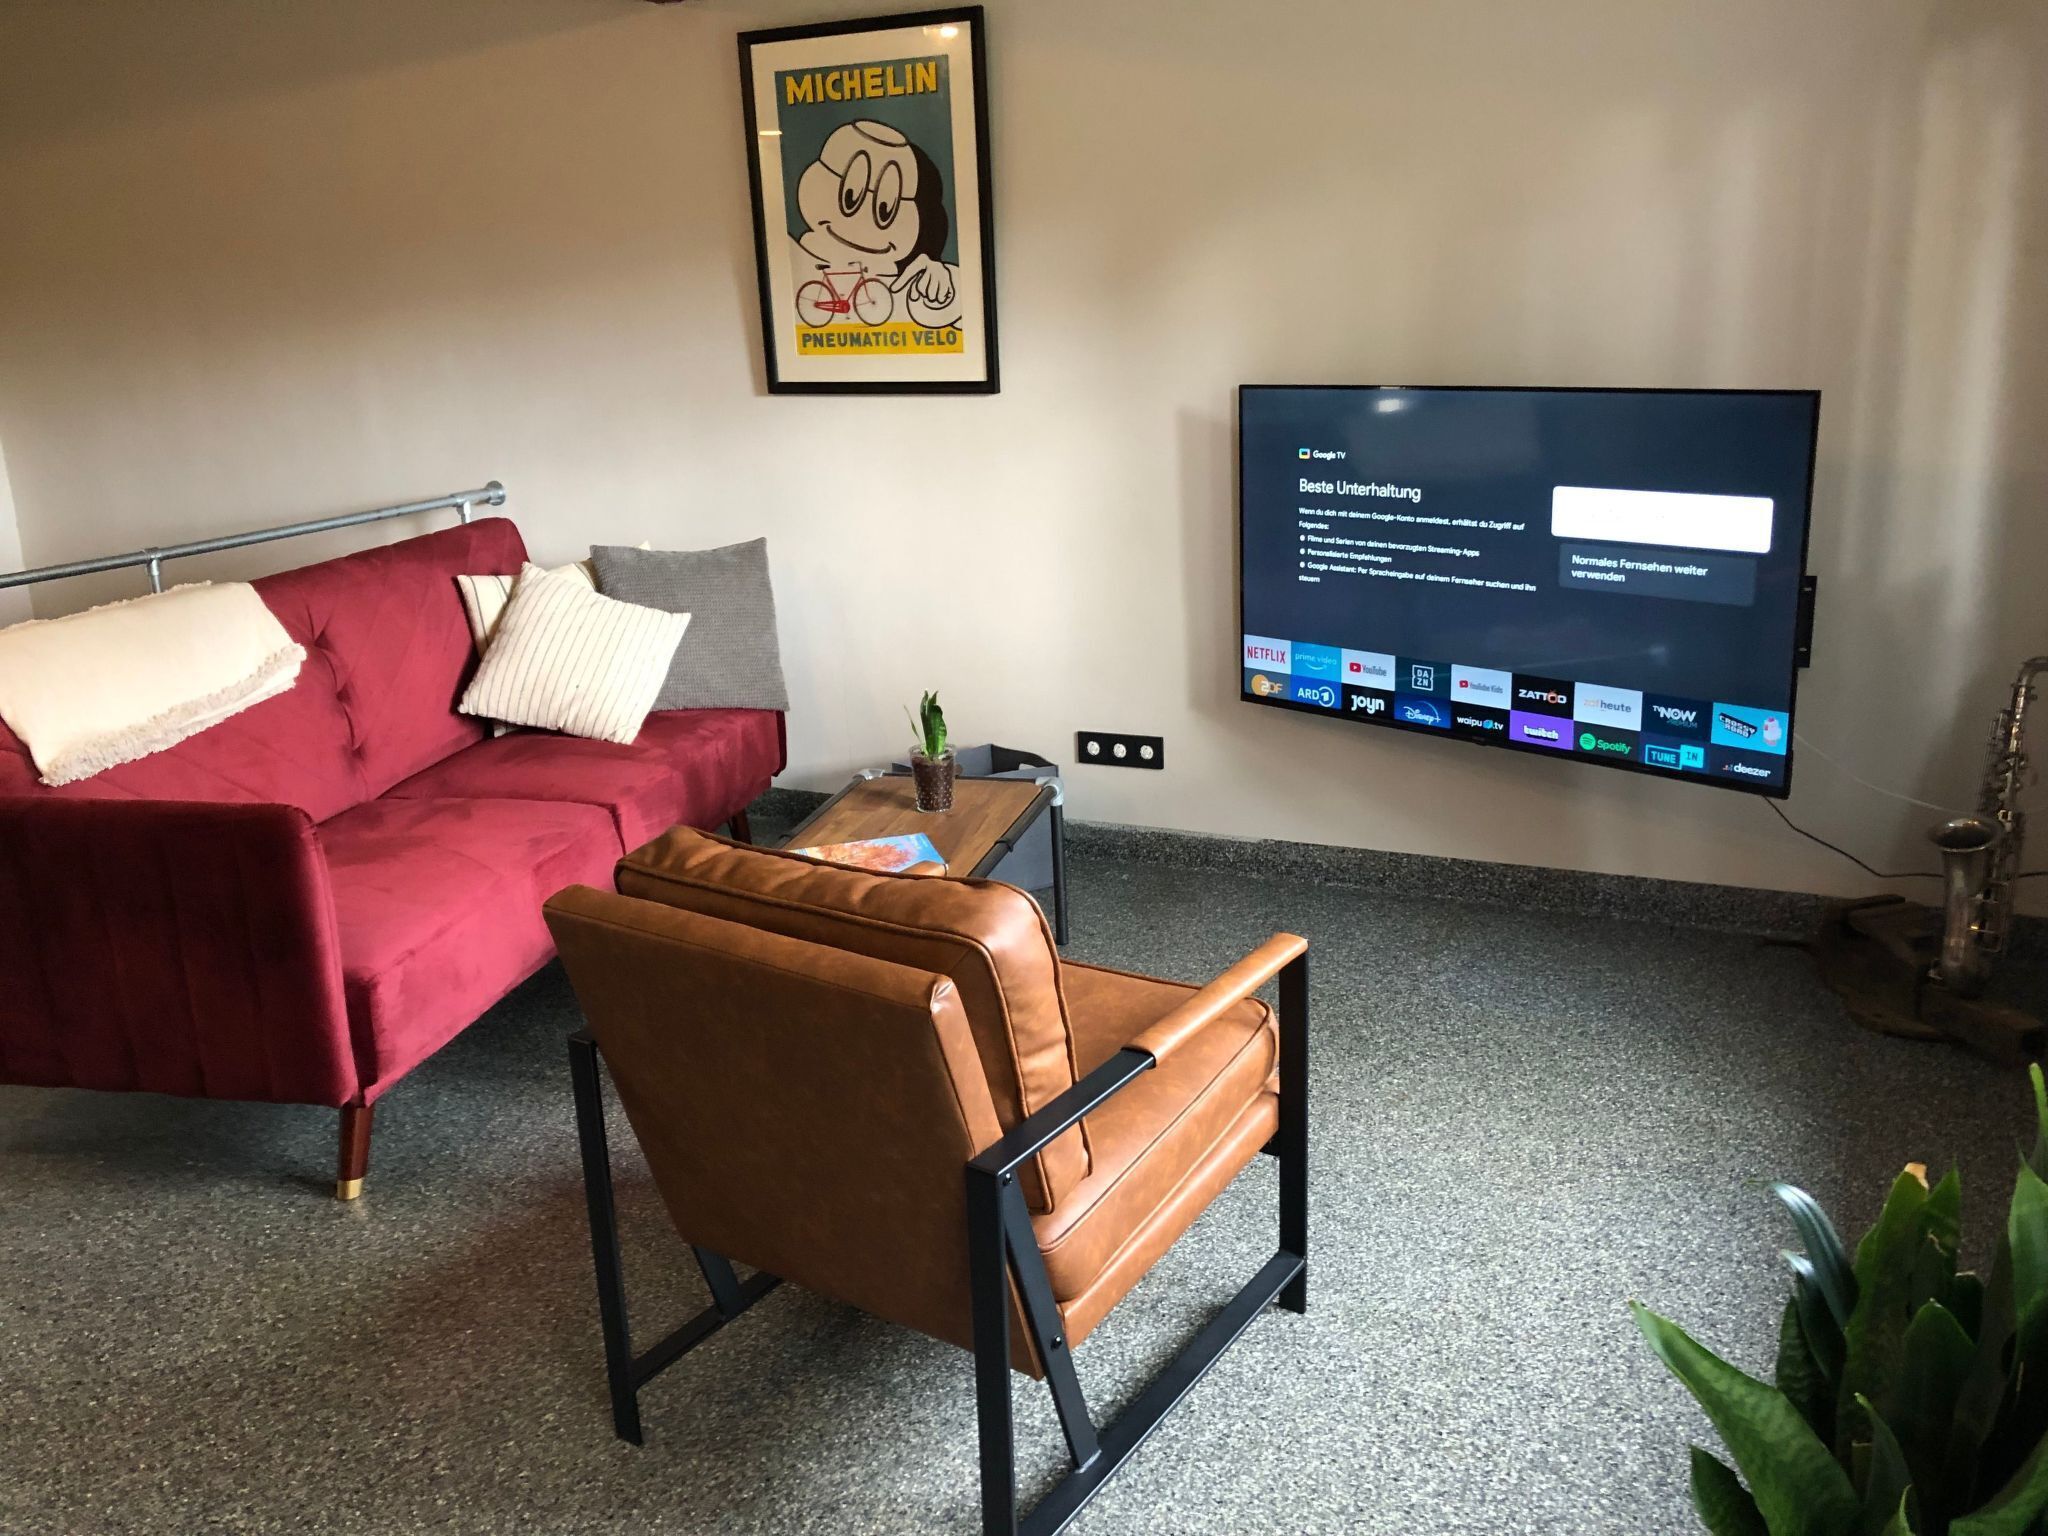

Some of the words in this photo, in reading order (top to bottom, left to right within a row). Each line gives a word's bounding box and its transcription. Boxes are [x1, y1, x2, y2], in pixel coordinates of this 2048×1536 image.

[785, 61, 937, 105] MICHELIN
[802, 331, 906, 348] PNEUMATICI
[912, 330, 957, 346] VELO
[1312, 450, 1336, 460] Google
[1299, 478, 1334, 493] Beste
[1336, 480, 1422, 503] Unterhaltung
[1299, 507, 1315, 515] Wenn
[1315, 508, 1323, 516] du
[1324, 509, 1336, 517] dich
[1348, 511, 1371, 519] deinem
[1371, 512, 1415, 522] Google-Konto
[1452, 518, 1478, 527] erhältst
[1479, 520, 1488, 528] du
[1489, 521, 1512, 531] Zugriff
[1299, 520, 1330, 530] Folgendes:
[1307, 534, 1323, 543] Filme
[1323, 536, 1335, 544] und
[1335, 537, 1354, 545] Serien
[1366, 540, 1388, 549] deinen
[1388, 542, 1427, 553] bevorzugten
[1307, 548, 1348, 559] Personalisierte
[1349, 552, 1392, 564] Empfehlungen
[1571, 554, 1618, 569] Normales
[1619, 558, 1673, 574] Fernsehen
[1674, 564, 1708, 577] weiter
[1307, 561, 1329, 571] Google
[1329, 564, 1356, 573] Assistant:
[1357, 566, 1368, 574] Per
[1368, 568, 1414, 580] Spracheingabe
[1426, 574, 1450, 583] deinem
[1451, 576, 1484, 587] Fernseher
[1485, 580, 1510, 590] suchen
[1510, 583, 1524, 591] und
[1524, 584, 1537, 592] ihn
[1571, 569, 1626, 583] verwenden
[1247, 646, 1286, 664] NETFLIX
[1294, 652, 1315, 662] prime
[1316, 655, 1337, 665] video
[1362, 664, 1387, 677] YouTube
[1416, 669, 1429, 678] DA
[1260, 680, 1283, 694] ZDF
[1416, 678, 1429, 687] ZN
[1523, 724, 1559, 740] twitch
[1719, 715, 1756, 734] CROSSY
[1724, 724, 1749, 738] ROAD
[1596, 739, 1632, 755] Spotify
[1650, 750, 1677, 764] TUNE
[1686, 751, 1698, 761] IN
[1733, 762, 1771, 778] deezer
